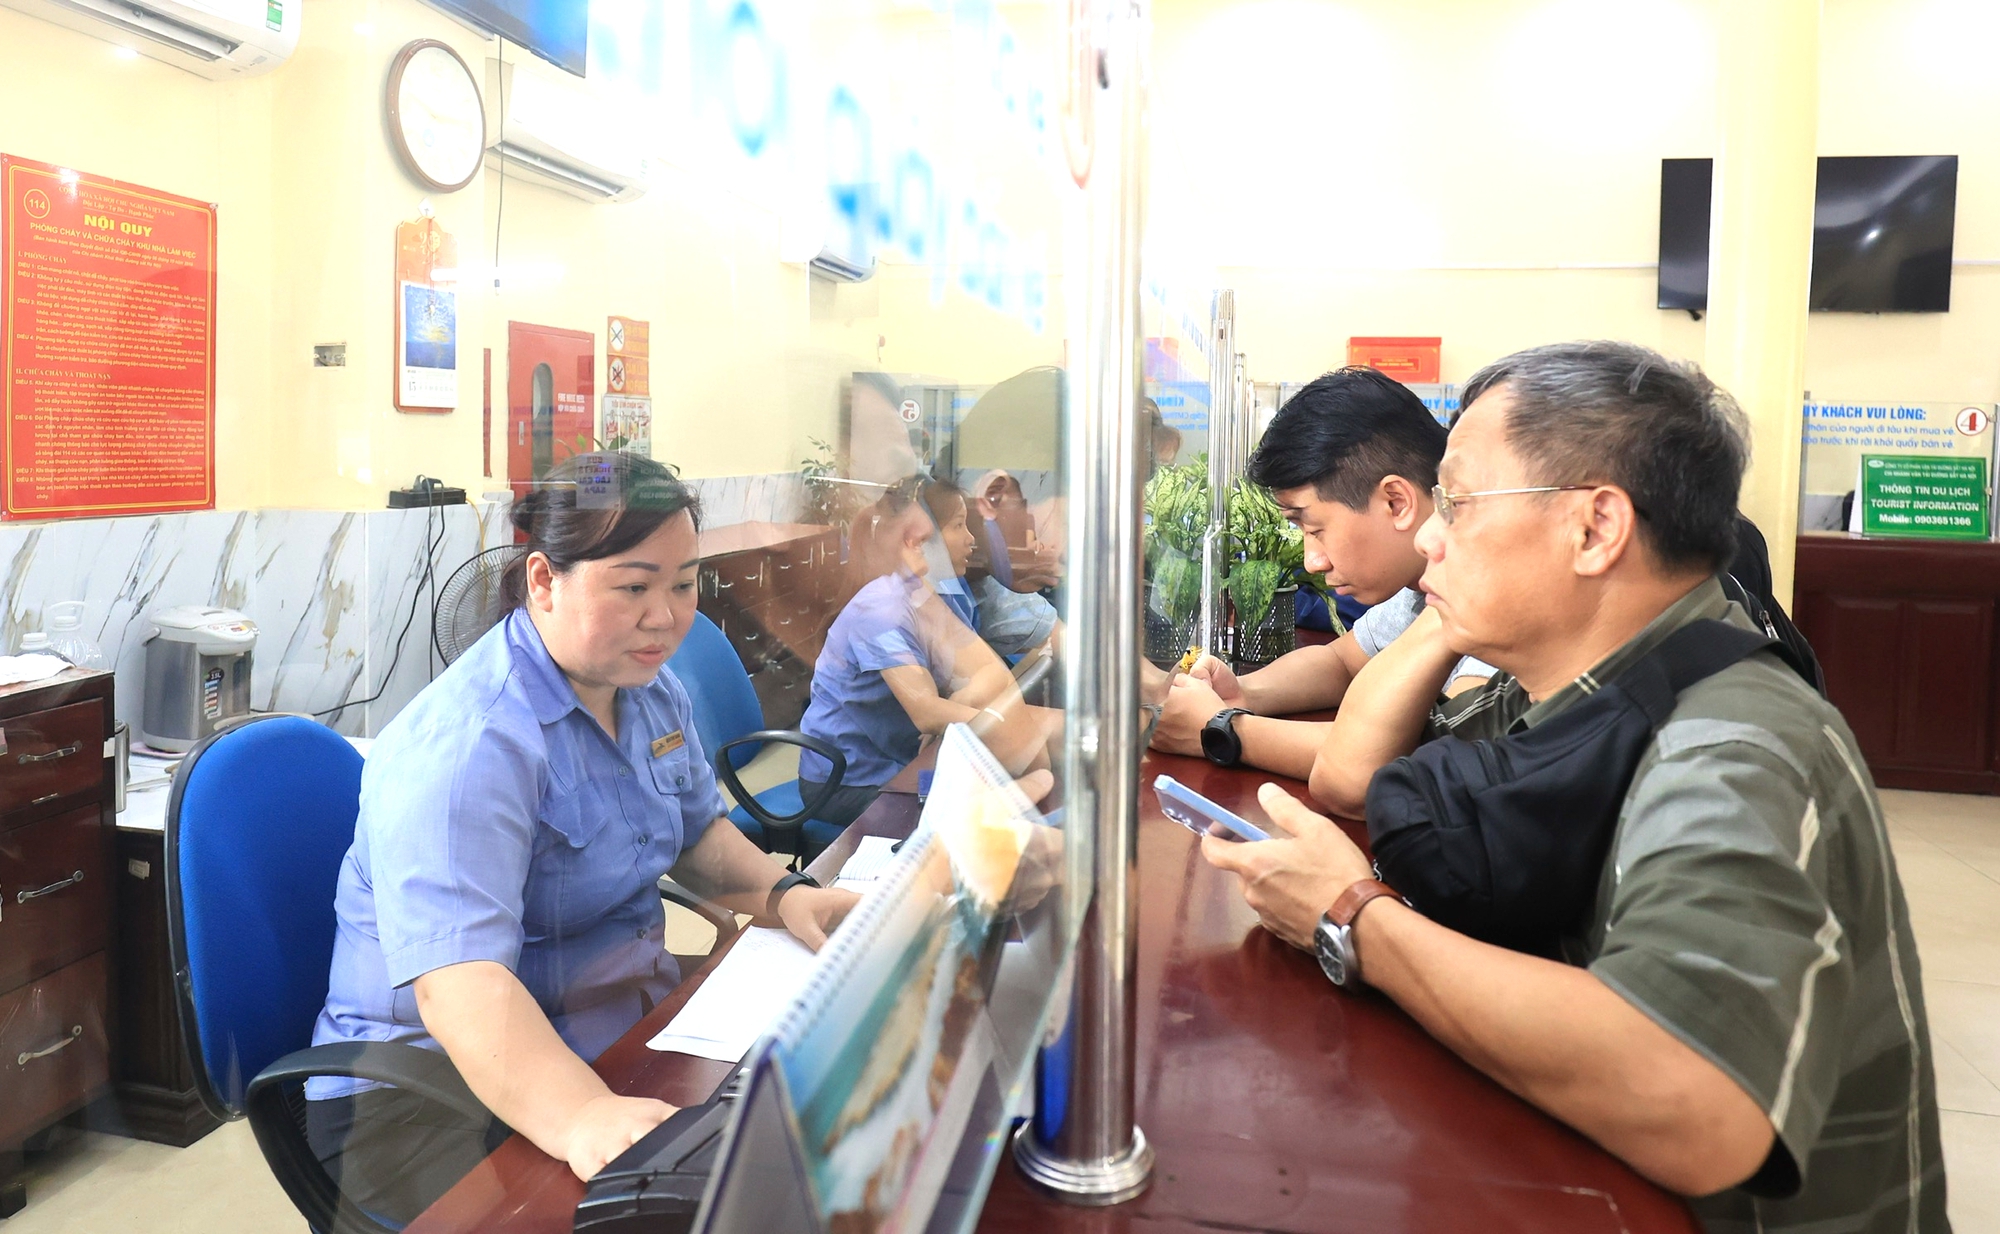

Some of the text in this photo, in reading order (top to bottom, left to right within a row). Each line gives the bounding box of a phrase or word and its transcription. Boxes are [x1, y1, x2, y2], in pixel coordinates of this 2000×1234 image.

[29, 198, 45, 209] 114
[84, 212, 152, 239] NỘI QUY
[30, 221, 57, 234] PHÒNG
[59, 226, 79, 238] CHÁY
[82, 230, 92, 240] VÀ
[93, 232, 114, 244] CHỮA
[115, 236, 134, 248] CHÁY
[136, 240, 150, 250] KHU
[182, 249, 196, 259] VIỆC
[1822, 403, 1862, 418] KHÁCH
[1867, 407, 1886, 419] VUI
[1890, 406, 1926, 420] LÒNG:
[1960, 412, 1979, 431] 4
[1830, 423, 1846, 432] của
[1849, 424, 1874, 434] người
[1876, 424, 1885, 433] đi
[1887, 425, 1902, 433] tàu
[1904, 426, 1917, 434] khi
[1820, 437, 1843, 445] trước
[1845, 437, 1858, 445] khi
[1861, 438, 1871, 446] rời
[1874, 438, 1893, 447] khỏi
[1921, 440, 1939, 448] bán
[1879, 483, 1970, 498] THÔNG TIN DU LỊCH
[1871, 499, 1979, 511] TOURIST INFORMATION
[1879, 514, 1912, 524] Mobile:
